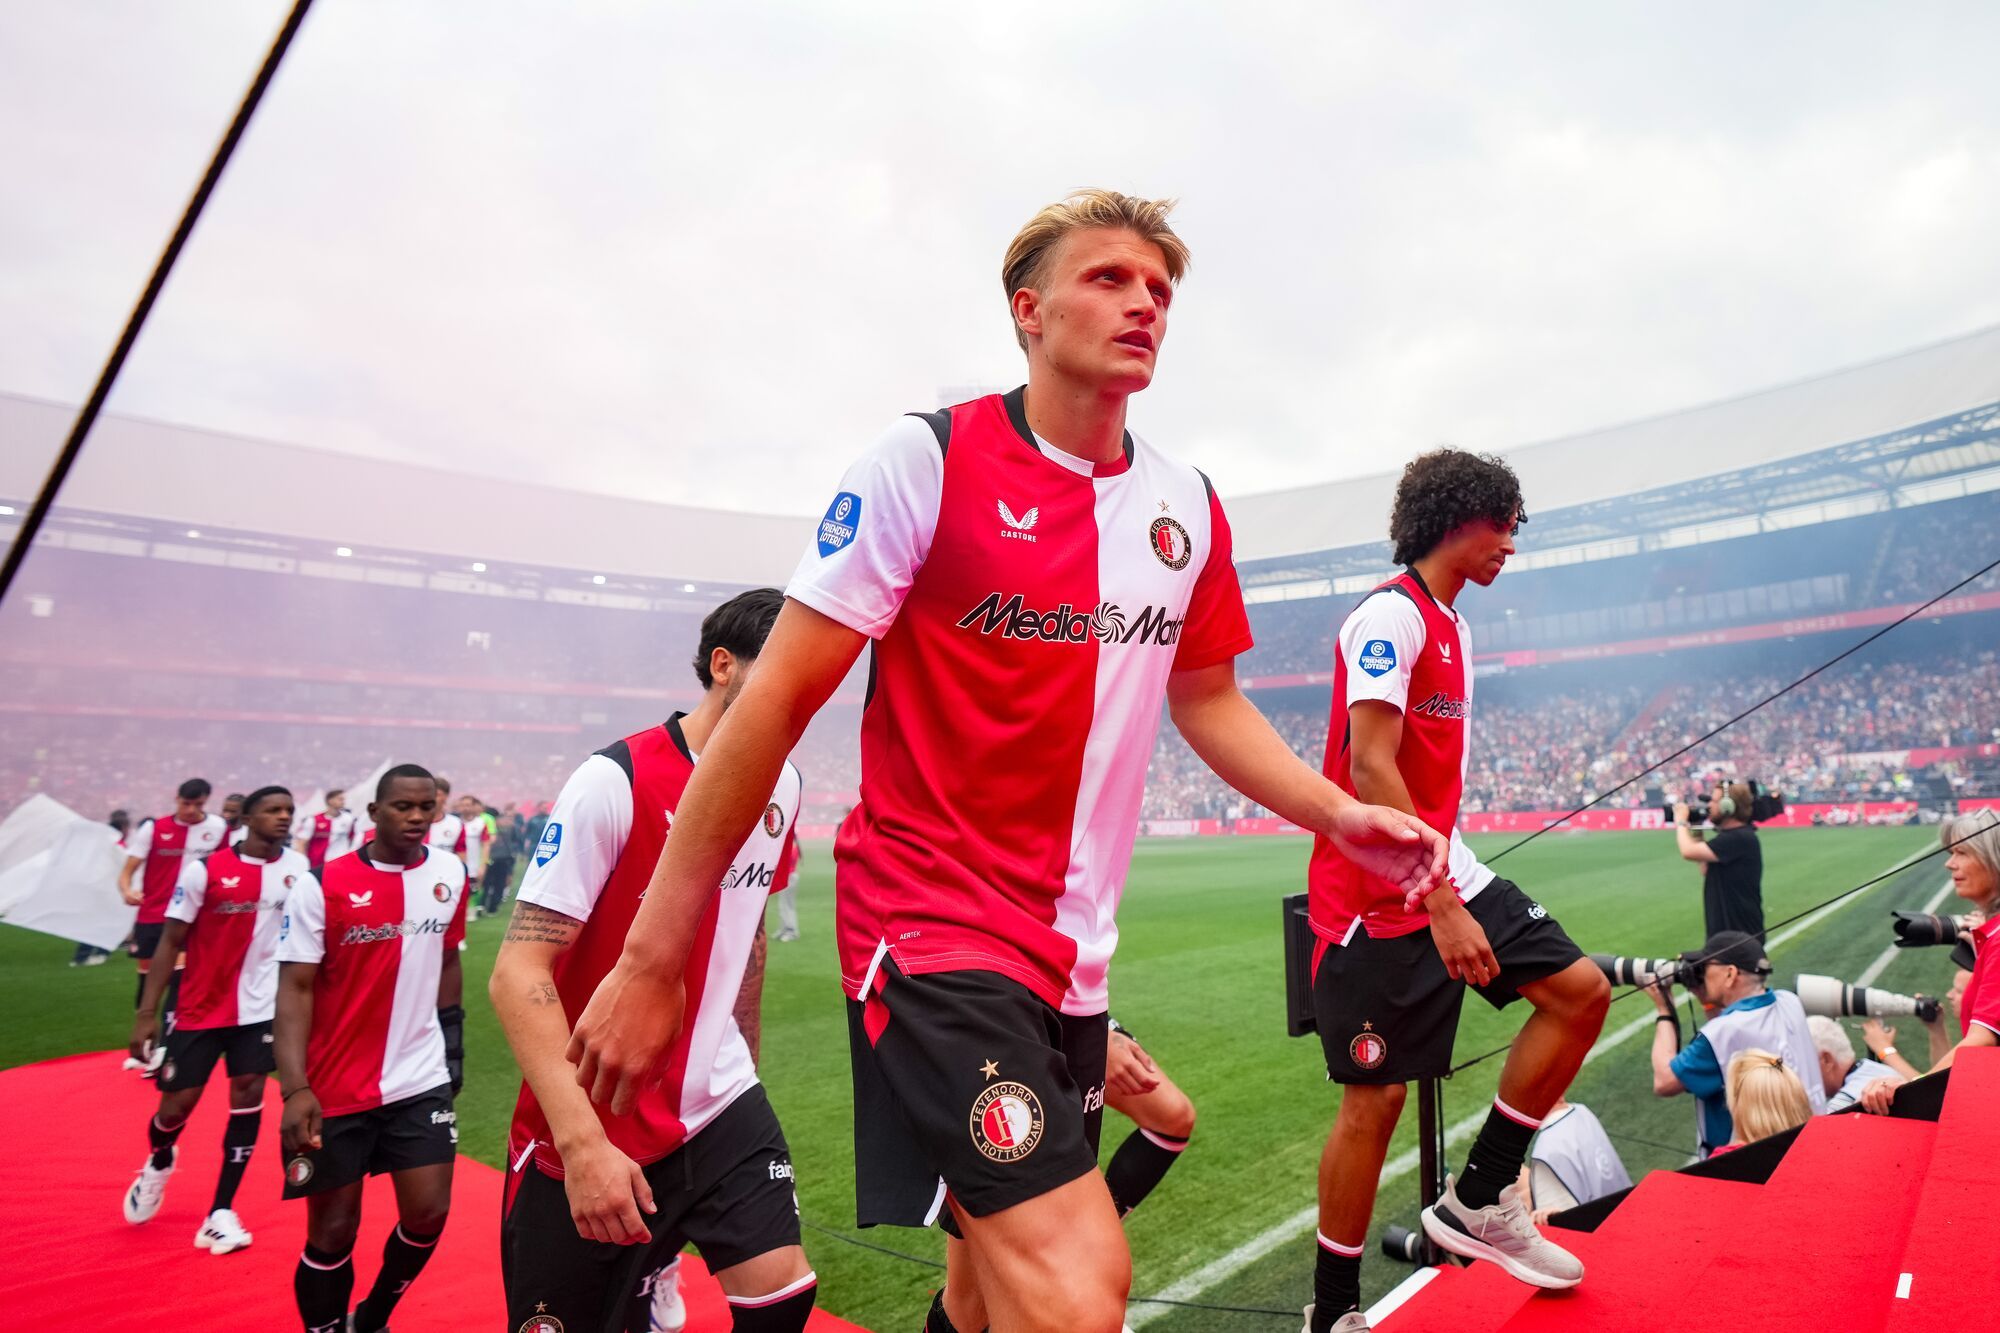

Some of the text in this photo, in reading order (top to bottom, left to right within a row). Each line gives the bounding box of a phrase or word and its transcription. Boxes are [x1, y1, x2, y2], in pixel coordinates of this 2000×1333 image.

[822, 521, 853, 539] VRIENDEN
[1000, 530, 1037, 543] CASTORE
[1151, 518, 1187, 538] FEYENOORD
[819, 531, 844, 548] LOTERIJ
[1154, 547, 1190, 568] ROTTERDAM
[955, 592, 1092, 644] Media
[973, 1085, 1032, 1122] FEYENOORD
[980, 1120, 1042, 1160] ROTTERDAM
